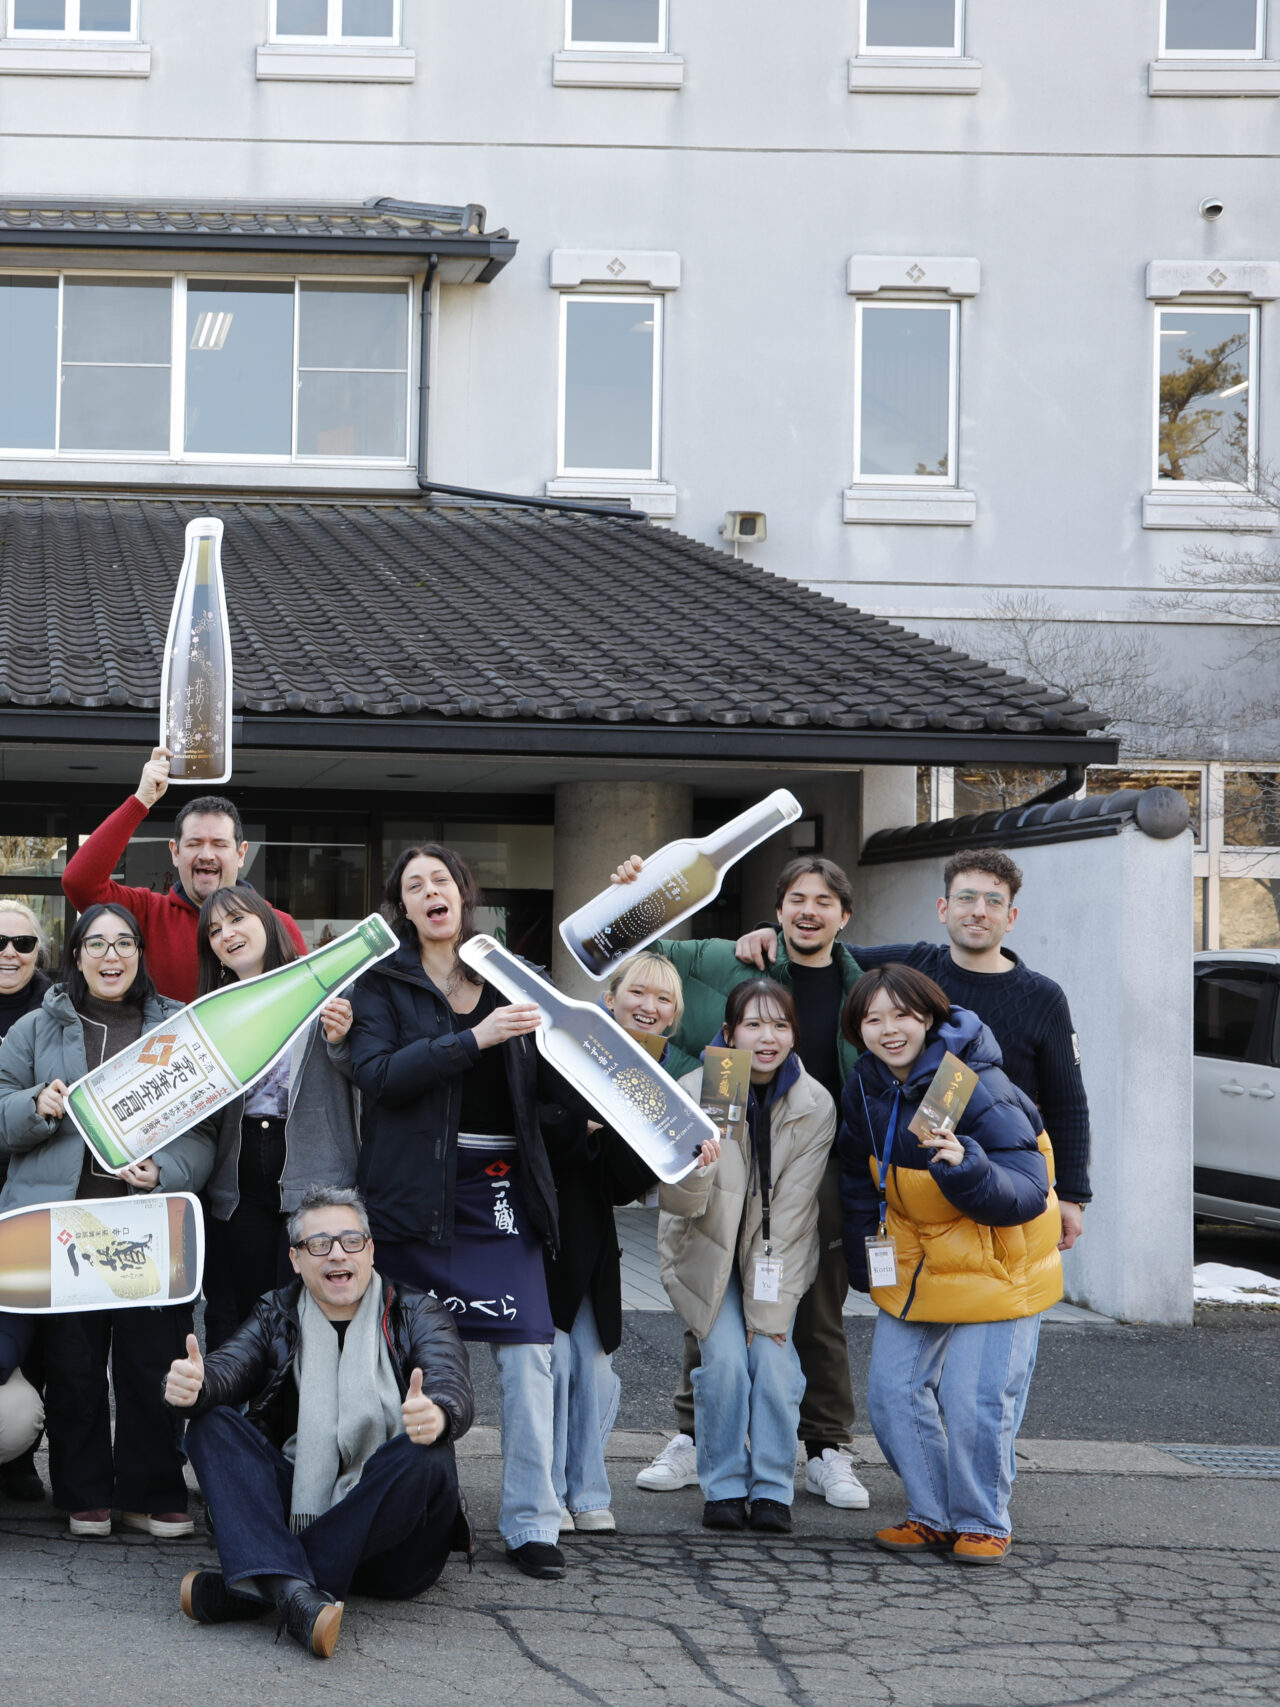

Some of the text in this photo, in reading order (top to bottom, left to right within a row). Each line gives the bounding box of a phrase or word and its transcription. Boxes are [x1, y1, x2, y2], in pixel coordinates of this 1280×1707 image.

[192, 1042, 216, 1073] 日本酒
[582, 1039, 608, 1066] すず音
[602, 1061, 619, 1075] GALA
[111, 1055, 197, 1122] 令和八年丙午二月四日
[491, 1180, 519, 1235] 一ノ蔵
[67, 1233, 153, 1277] 一ノ蔵
